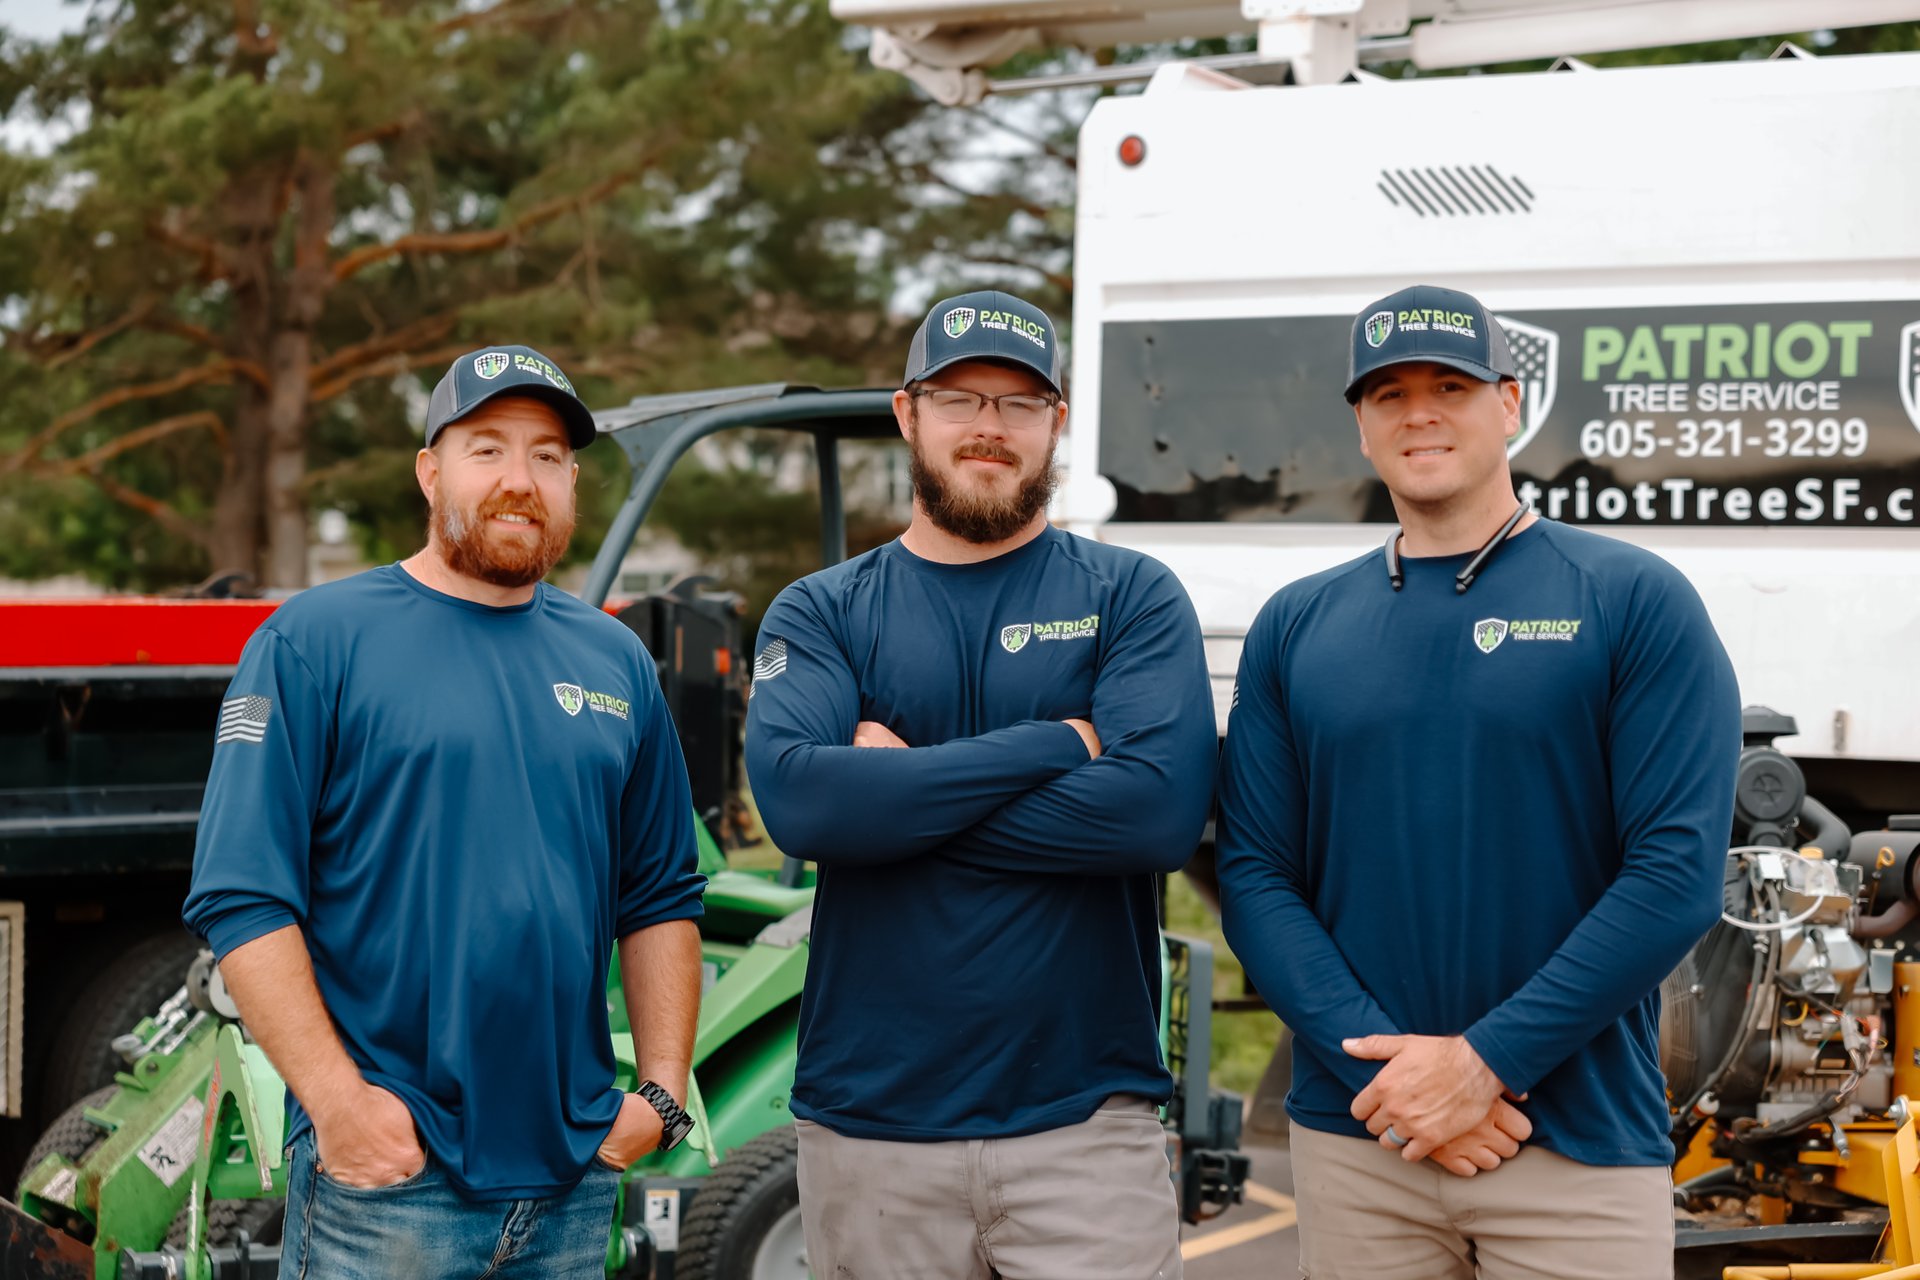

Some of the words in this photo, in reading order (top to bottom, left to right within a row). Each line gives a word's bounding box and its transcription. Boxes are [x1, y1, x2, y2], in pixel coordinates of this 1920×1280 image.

[979, 310, 1046, 340] PATRIOT
[1398, 308, 1474, 329] PATRIOT
[980, 320, 1009, 331] TREE
[1011, 326, 1046, 349] SERVICE
[1398, 322, 1429, 332] TREE
[1432, 322, 1476, 339] SERVICE
[1581, 320, 1874, 381] PATRIOT
[514, 354, 571, 393] PATRIOT
[515, 363, 543, 376] TREE
[1603, 382, 1689, 412] TREE
[1696, 381, 1841, 411] SERVICE
[1579, 417, 1869, 458] 605-321-3299
[1033, 615, 1100, 635] PATRIOT
[1038, 633, 1060, 641] TREE
[1061, 629, 1095, 640] SERVICE
[1509, 620, 1581, 634] PATRIOT
[1513, 632, 1535, 641] TREE
[1536, 632, 1573, 641] SERVICE
[583, 690, 630, 714] PATRIOT
